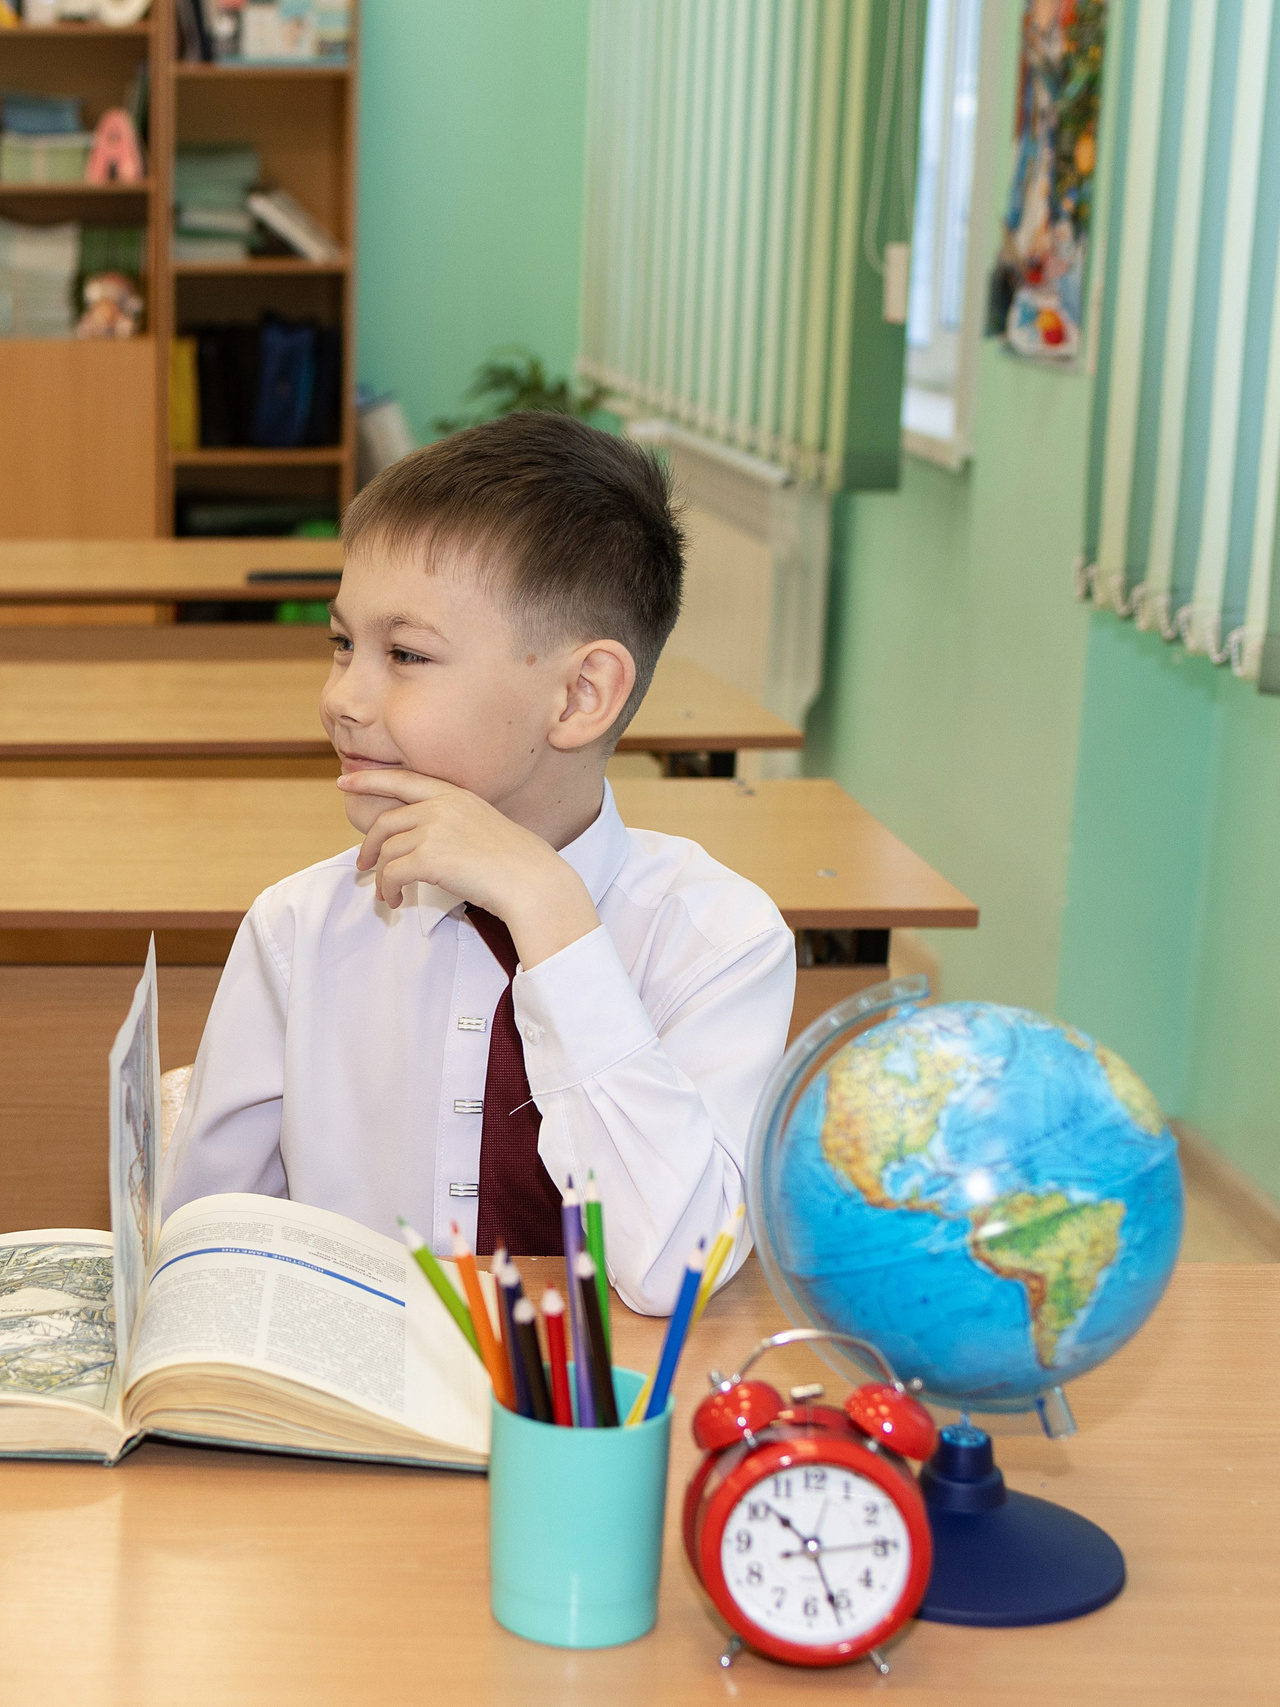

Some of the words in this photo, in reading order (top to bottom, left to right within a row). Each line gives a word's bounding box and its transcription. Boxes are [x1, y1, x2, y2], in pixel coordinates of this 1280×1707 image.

[221, 1248, 269, 1257] ЗАМЕТКИ
[272, 1254, 324, 1273] КОРОТКИЕ
[773, 1476, 792, 1498] 11
[803, 1469, 827, 1490] 12
[843, 1480, 851, 1500] 1
[748, 1500, 770, 1521] 10
[863, 1502, 879, 1525] 2
[736, 1530, 752, 1553] 9
[746, 1562, 763, 1584] 8
[858, 1567, 873, 1588] 4
[772, 1587, 786, 1609] 7
[803, 1595, 819, 1617] 6
[835, 1588, 852, 1610] 5
